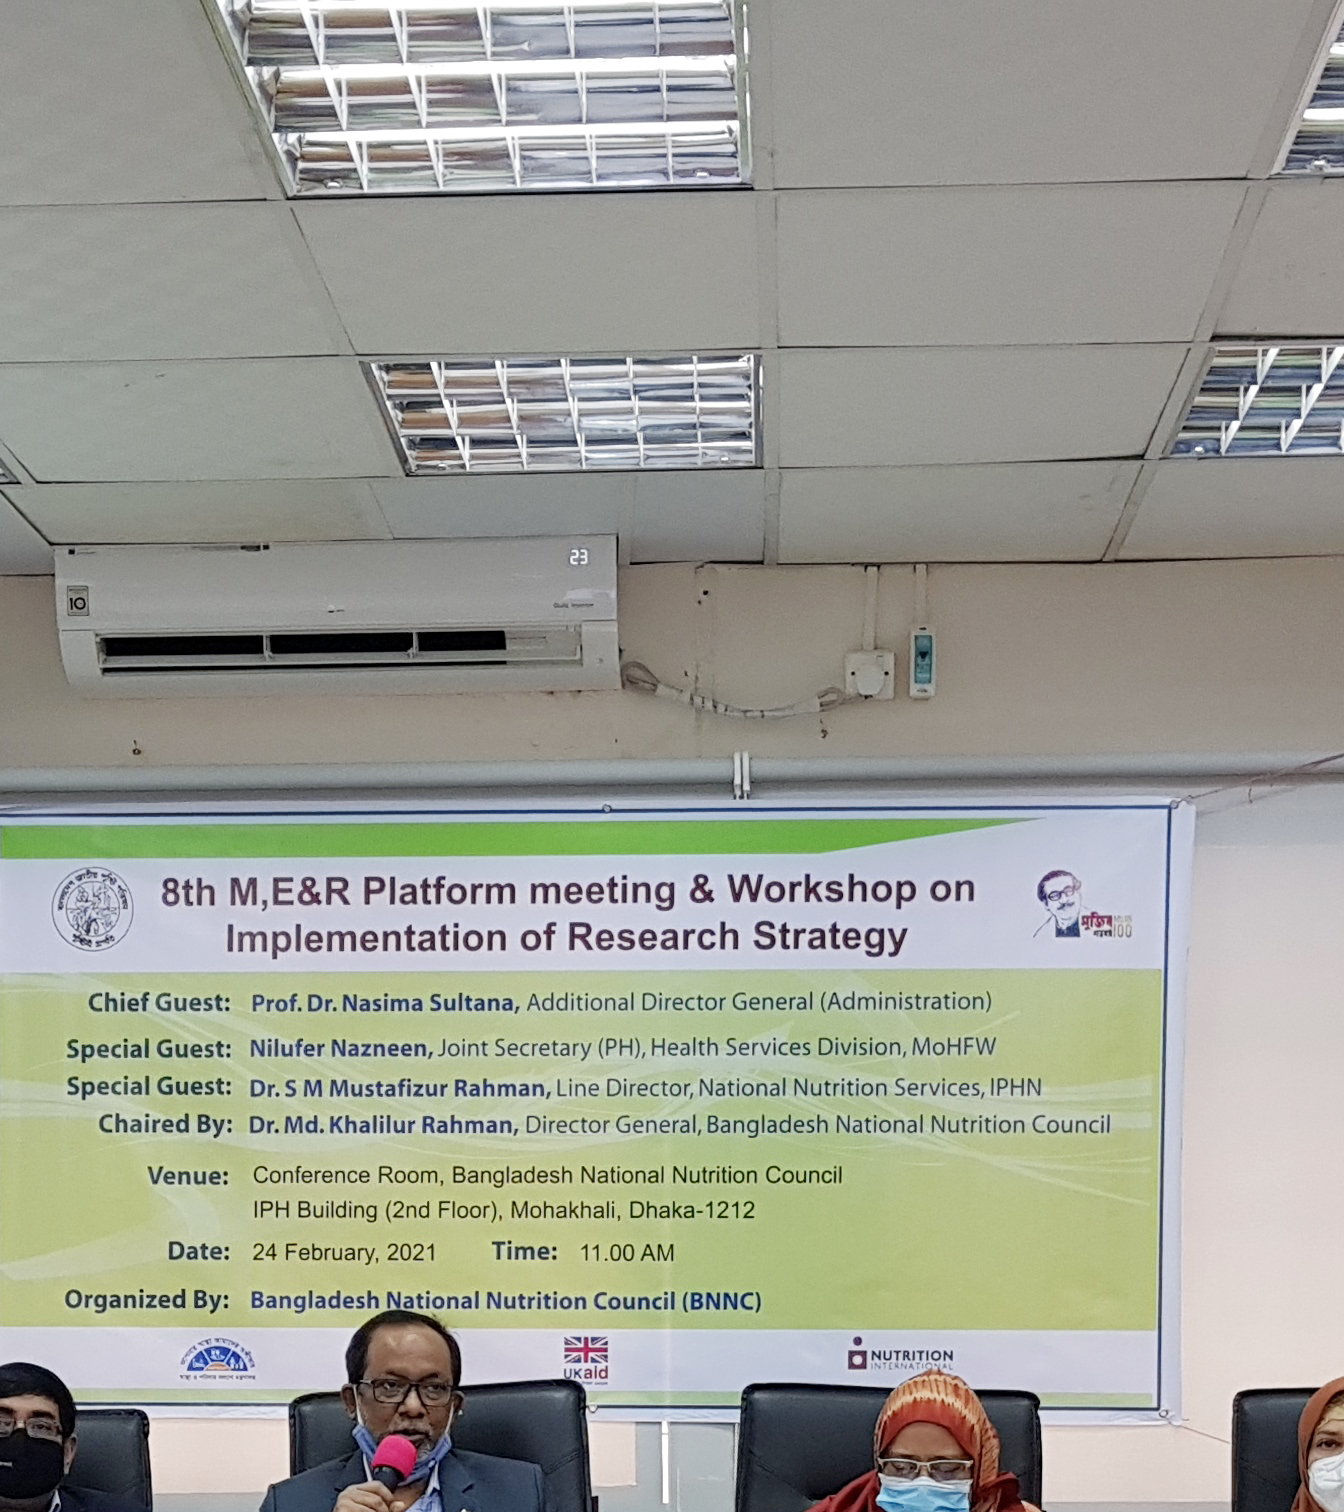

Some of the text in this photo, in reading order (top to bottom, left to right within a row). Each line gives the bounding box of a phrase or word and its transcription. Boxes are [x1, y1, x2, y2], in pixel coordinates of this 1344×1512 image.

[569, 549, 588, 565] 23
[161, 872, 975, 913] 8th M,E&R Platform meeting & Workshop on
[226, 919, 909, 960] Implementation of Research Strategy
[88, 990, 992, 1015] Chief Guest: Prof. Dr. Nasima Sultana, Additional Director General (Administration)
[66, 1036, 997, 1064] Special Guest: Nilufer Nazneen, Joint Secretary (PH), Health Services Division, MoHFW
[66, 1074, 1042, 1102] Special Guest: Dr. S M Mustafizur Rahman, Line Director, National Nutrition Services, IPHN
[98, 1112, 1111, 1139] Chaired By: Dr. Md. Khalilur Rahman, Director General, Bangladesh National Nutrition Council
[146, 1165, 843, 1189] Venue: Conference Room, Bangladesh National Nutrition Council
[253, 1199, 756, 1224] IPH Building (2nd Floor), Mohakhali, Dhaka-1212
[168, 1239, 675, 1266] Date: 24 February, 2021 Time: 11.00 AM
[64, 1287, 762, 1316] Organized By: Bangladesh National Nutrition Council (BNNC)
[870, 1349, 955, 1362] NUTRITION
